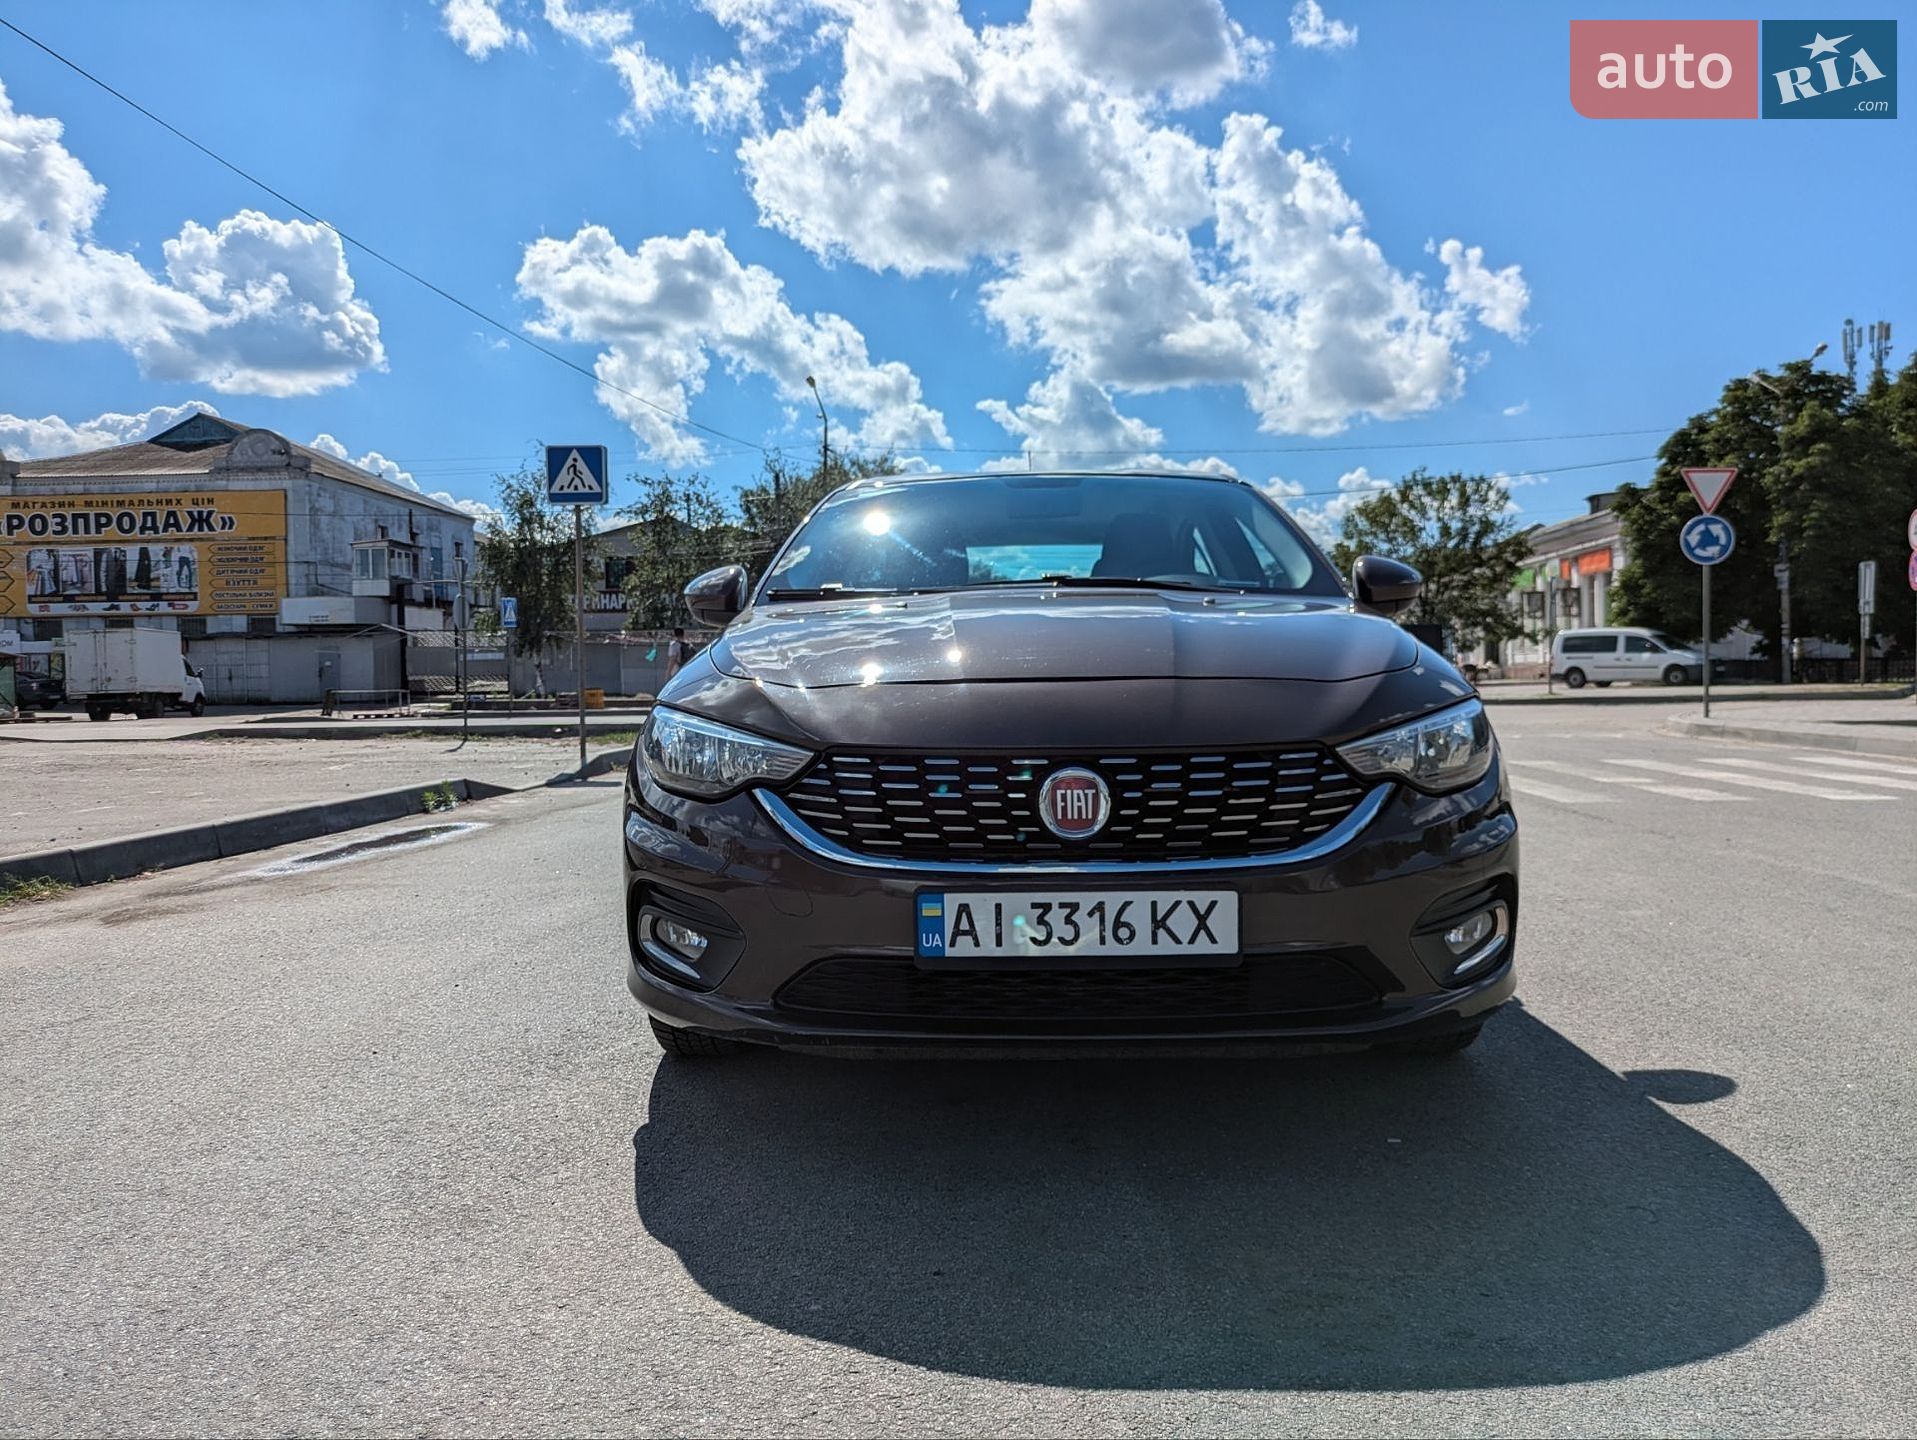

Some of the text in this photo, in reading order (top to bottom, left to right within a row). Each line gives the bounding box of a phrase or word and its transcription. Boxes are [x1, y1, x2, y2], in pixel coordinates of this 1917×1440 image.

[11, 497, 215, 510] МАГАЗИН МІНІМАЛЬНИХ ЦІН
[0, 510, 236, 537] РОЗПРОДАЖ»
[1056, 789, 1096, 820] FIAT
[949, 900, 1218, 948] AI 3316 KX
[922, 933, 943, 947] UA
